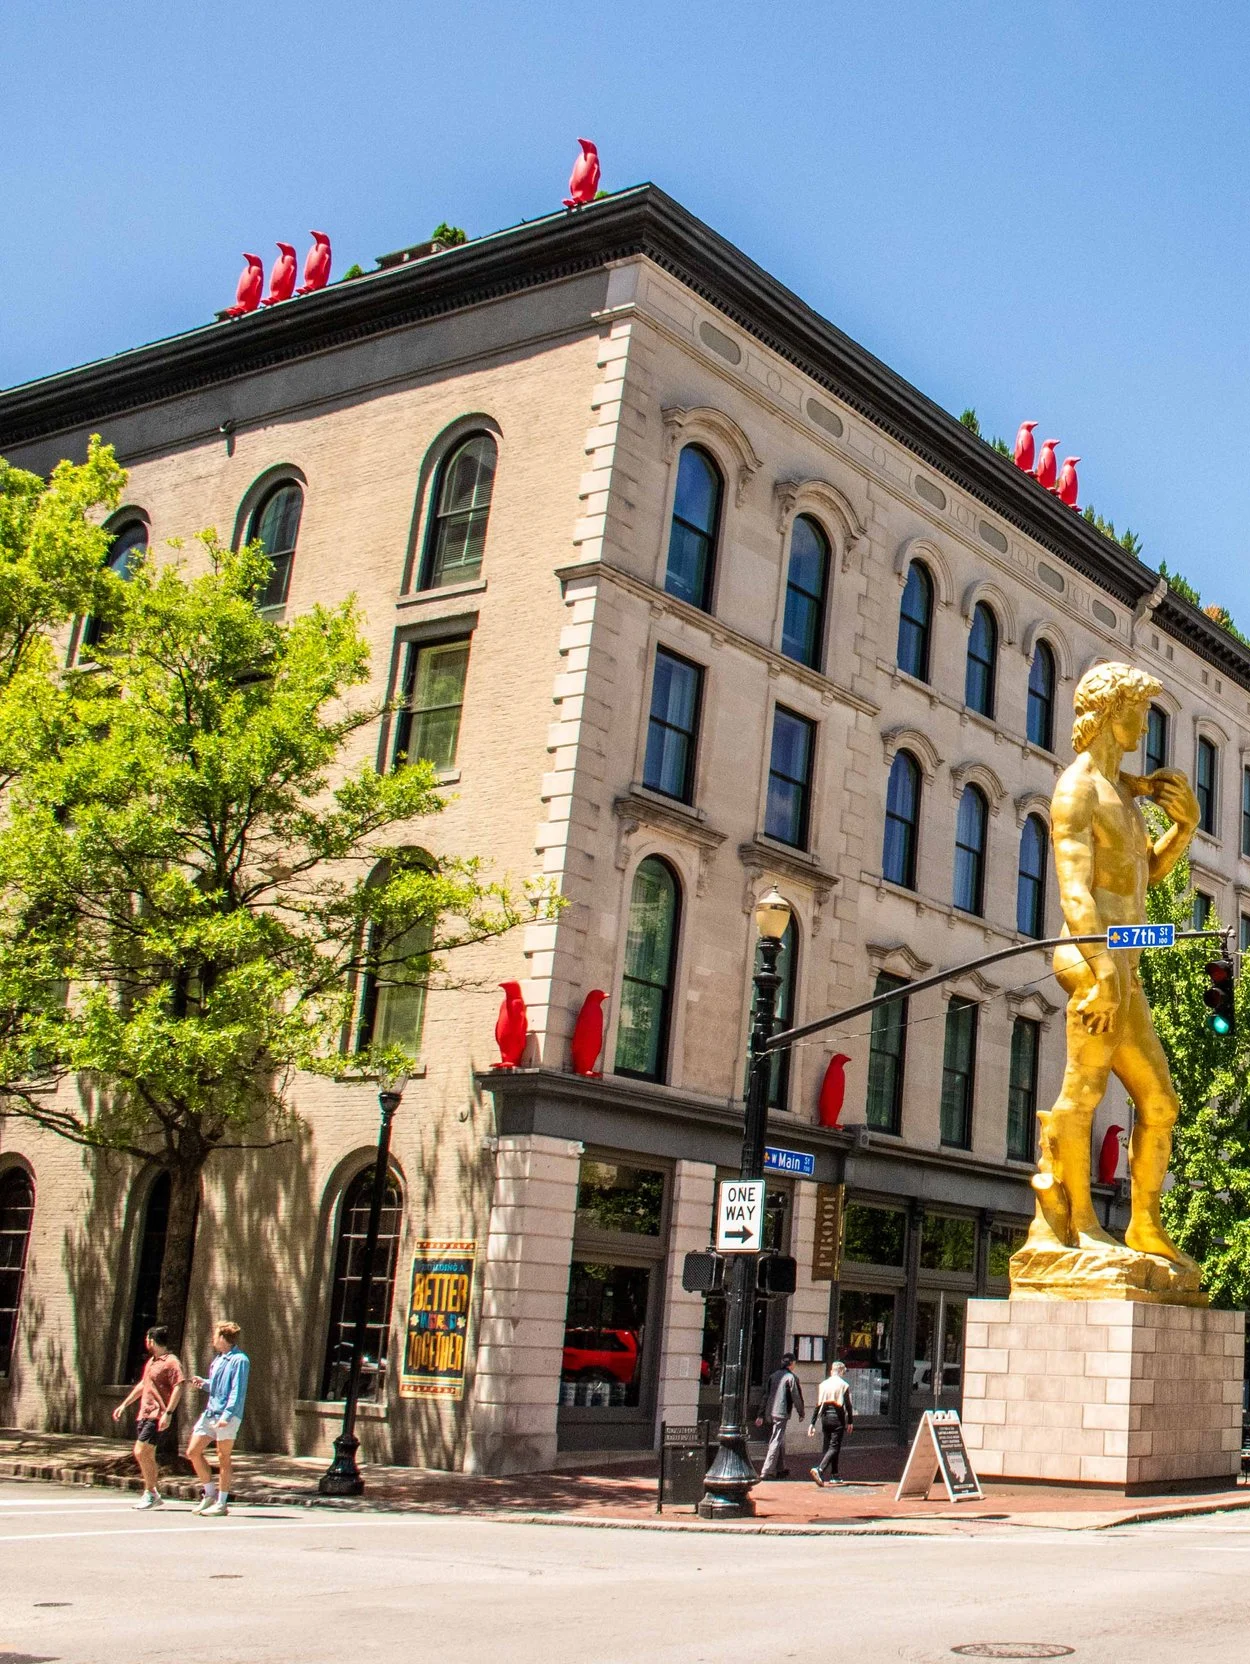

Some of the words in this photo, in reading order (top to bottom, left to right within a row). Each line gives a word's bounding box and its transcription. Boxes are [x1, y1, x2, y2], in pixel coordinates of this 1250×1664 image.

[1122, 931, 1129, 943] S
[1131, 928, 1156, 945] 7th
[1159, 927, 1168, 936] St
[778, 1152, 801, 1170] Main
[804, 1156, 811, 1166] St
[728, 1187, 756, 1202] ONE
[726, 1205, 756, 1221] WAY
[412, 1273, 469, 1313] BETTER
[408, 1330, 464, 1372] TOGETHER
